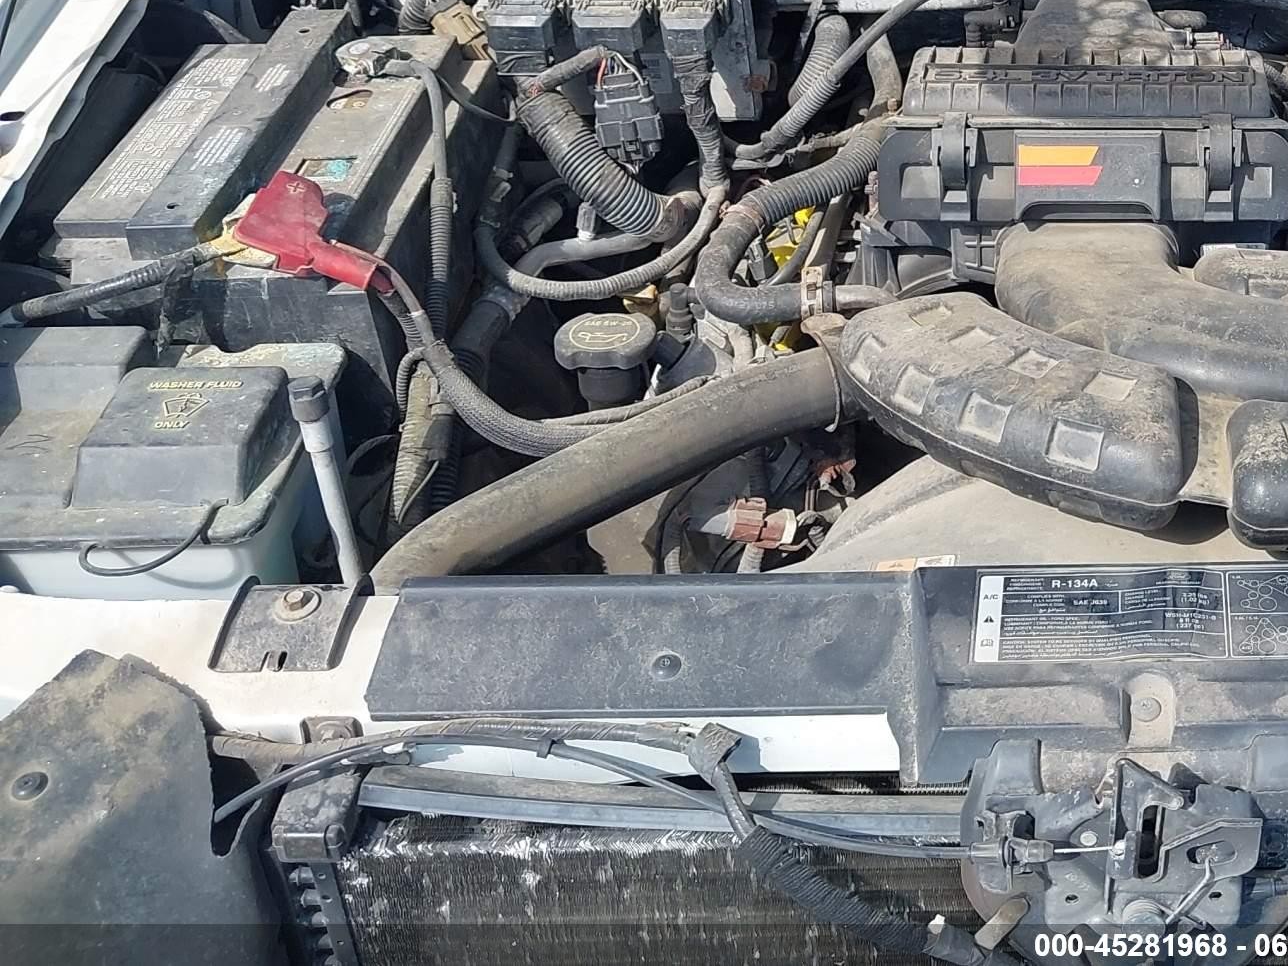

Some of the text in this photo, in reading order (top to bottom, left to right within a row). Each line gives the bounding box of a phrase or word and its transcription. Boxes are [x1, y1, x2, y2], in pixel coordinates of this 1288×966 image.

[1097, 70, 1245, 83] TRITON
[149, 381, 243, 390] WASHER FLUID
[153, 420, 190, 429] ONLY
[1051, 579, 1098, 588] R-134A
